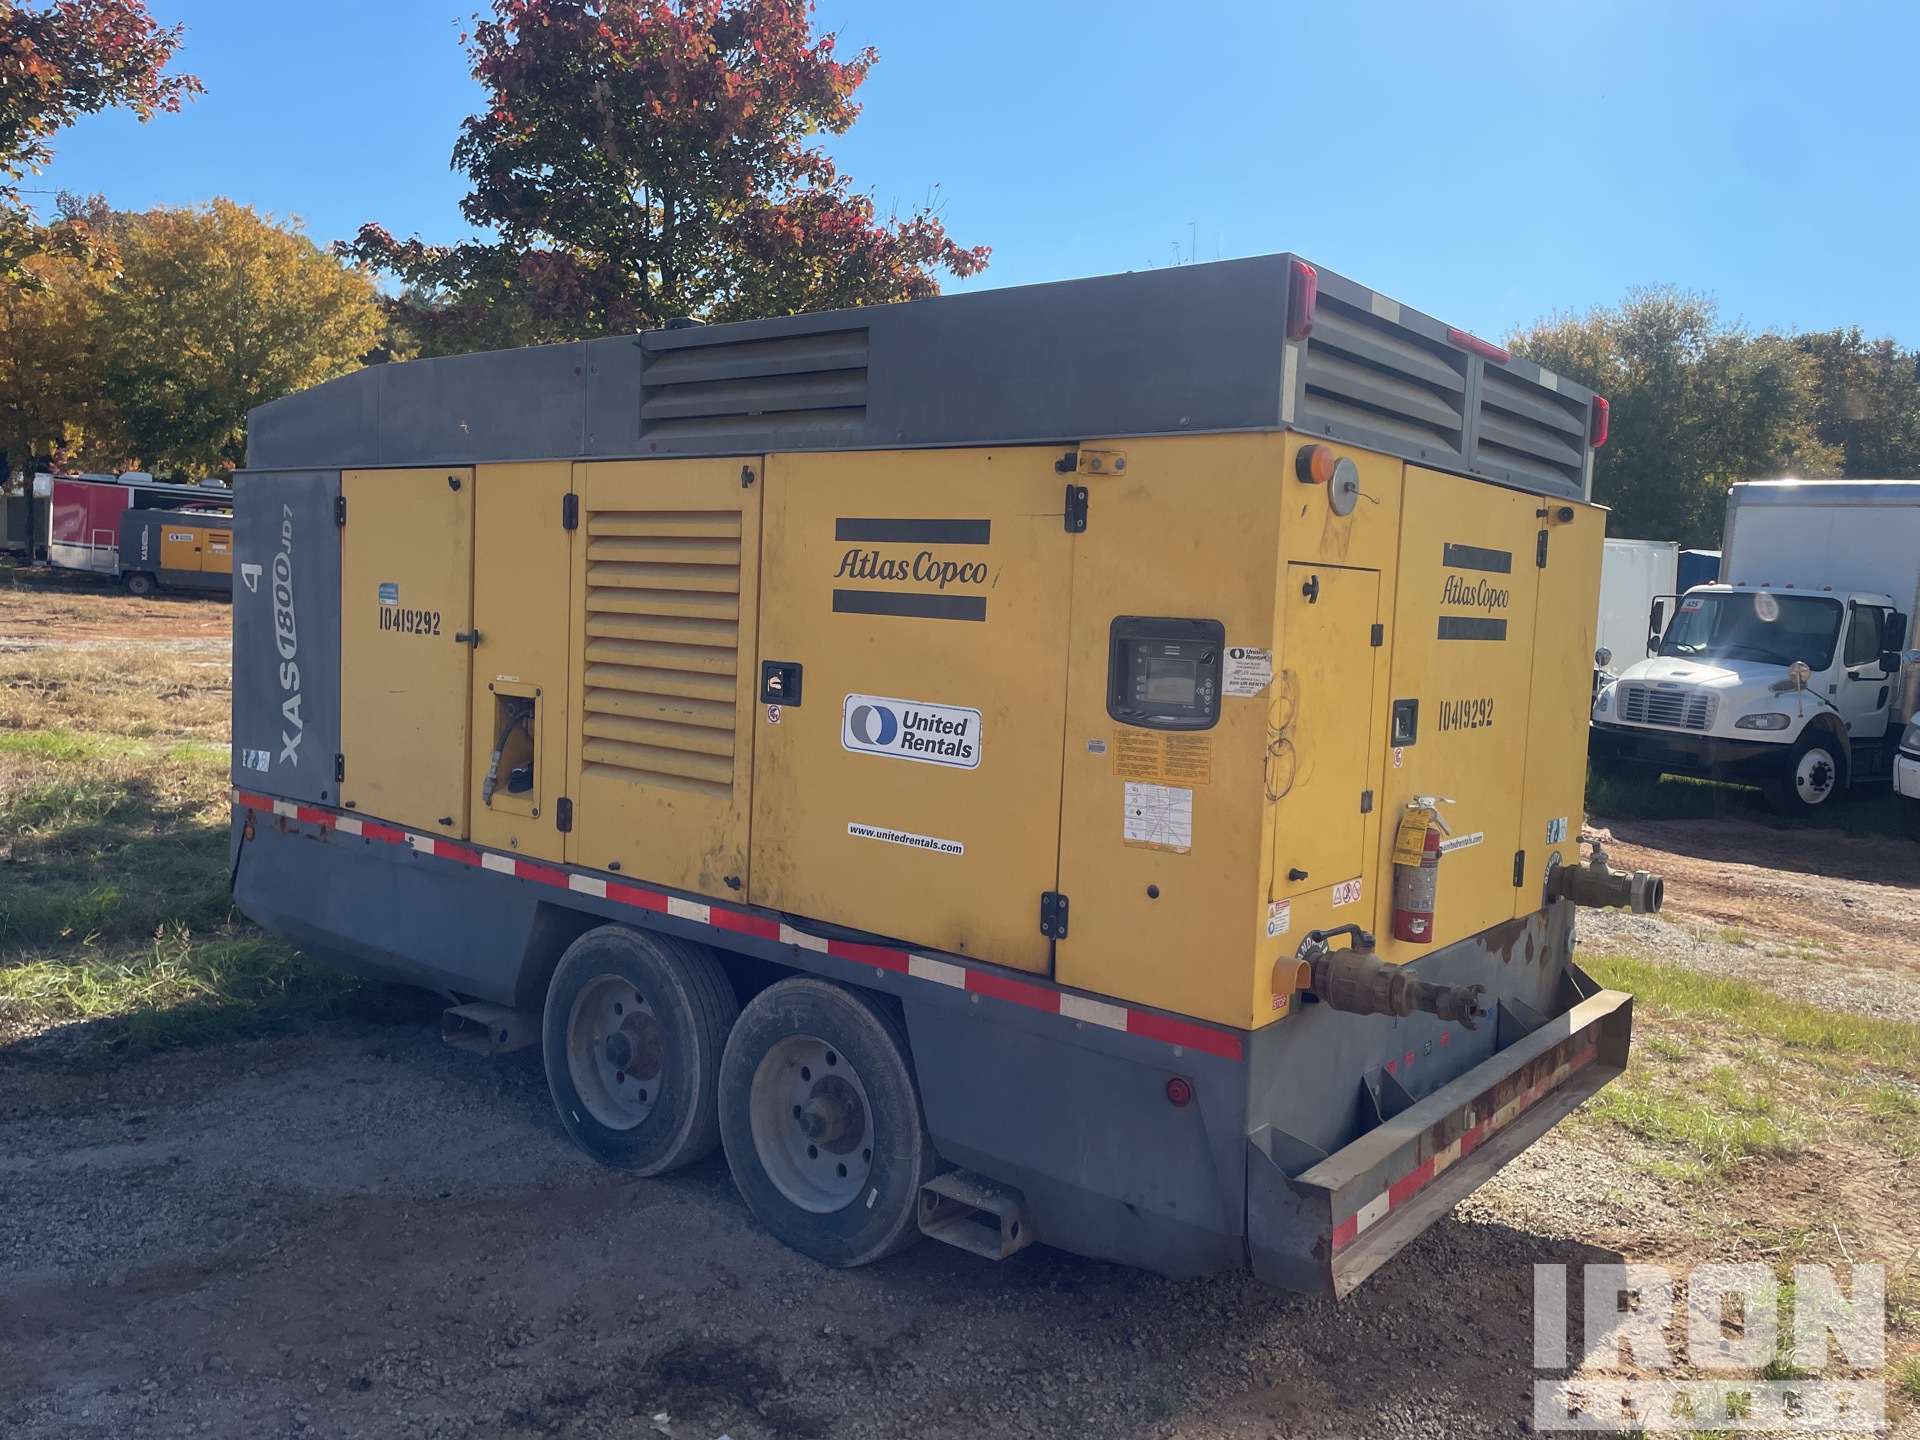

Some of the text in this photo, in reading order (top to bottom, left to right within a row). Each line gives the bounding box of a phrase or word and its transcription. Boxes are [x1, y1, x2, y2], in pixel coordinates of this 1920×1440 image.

[241, 563, 263, 593] 4
[834, 549, 988, 589] Atlas Copco
[1440, 575, 1509, 613] Atlas Copco
[380, 606, 440, 636] 10419292
[903, 710, 968, 737] United
[1438, 697, 1494, 732] 10419292
[901, 731, 973, 758] Rentals
[850, 826, 962, 853] www.unitedrentals.com
[1273, 997, 1286, 1010] STOP
